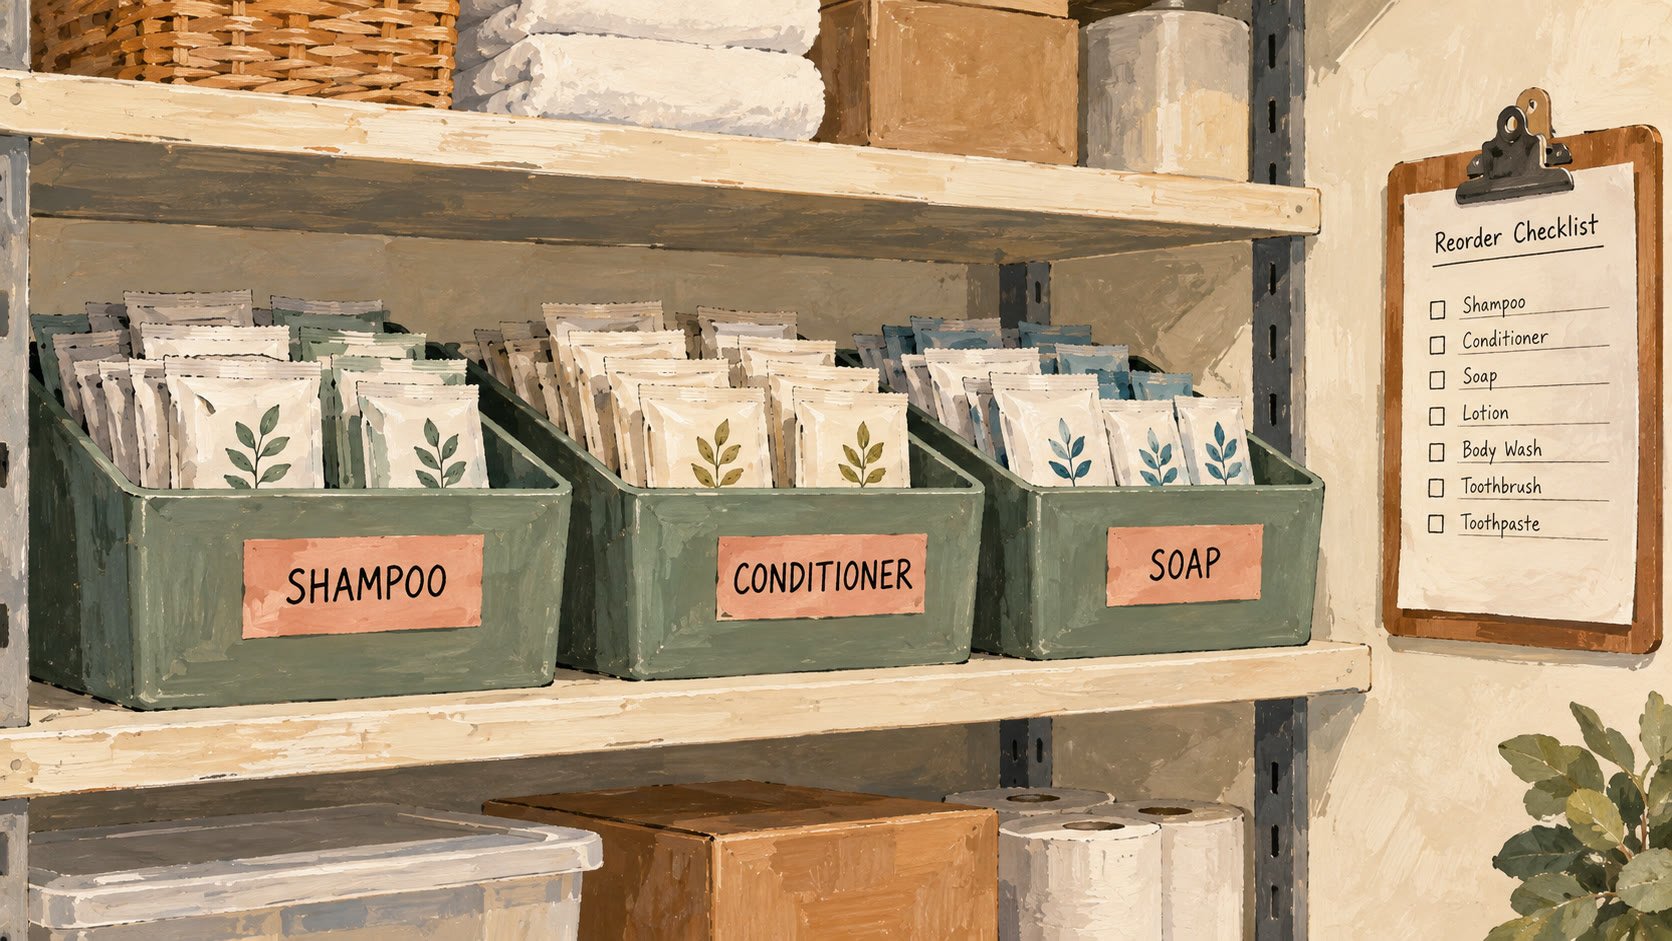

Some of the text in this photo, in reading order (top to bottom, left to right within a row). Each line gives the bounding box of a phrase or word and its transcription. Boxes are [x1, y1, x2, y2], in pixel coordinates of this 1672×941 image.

[1435, 213, 1599, 253] Reorder Checklist
[1463, 296, 1526, 317] Shampoo
[1463, 329, 1549, 348] Conditioner
[1463, 366, 1498, 390] Soap
[1463, 404, 1509, 421] Lotion
[1463, 438, 1542, 464] Body Wash
[1461, 476, 1542, 494] Toothbrush
[1460, 512, 1540, 538] Toothpaste
[733, 558, 913, 595] CONDITIONER
[1149, 546, 1221, 582] SOAP
[285, 564, 447, 605] SHAMPOO
